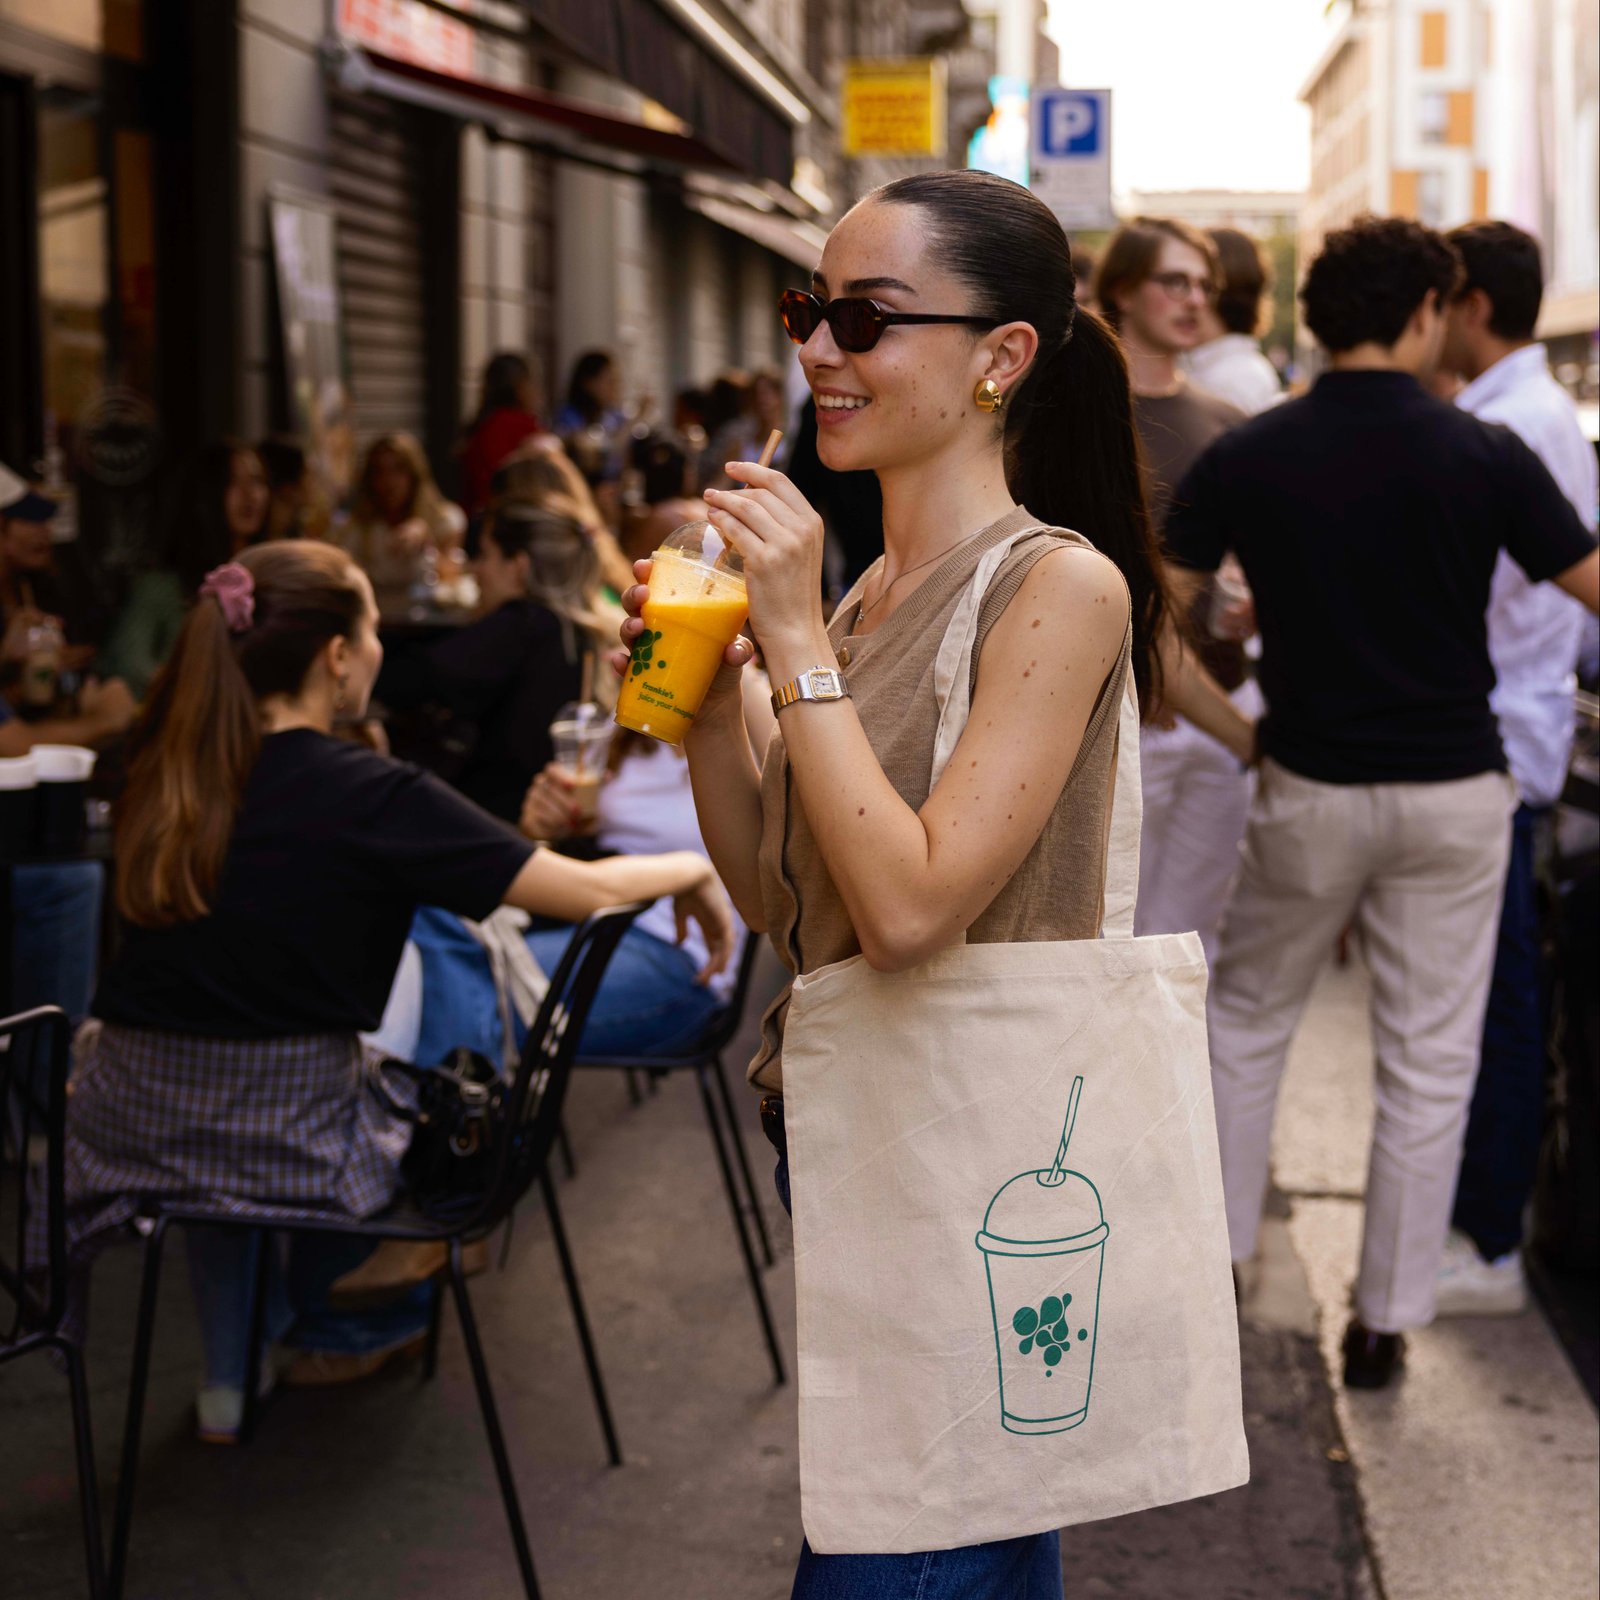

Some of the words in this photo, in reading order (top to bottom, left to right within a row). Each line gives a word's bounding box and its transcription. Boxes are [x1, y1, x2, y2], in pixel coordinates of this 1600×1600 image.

[1050, 101, 1092, 150] P
[642, 681, 674, 699] frankie's
[637, 692, 655, 703] juice
[655, 700, 673, 710] your
